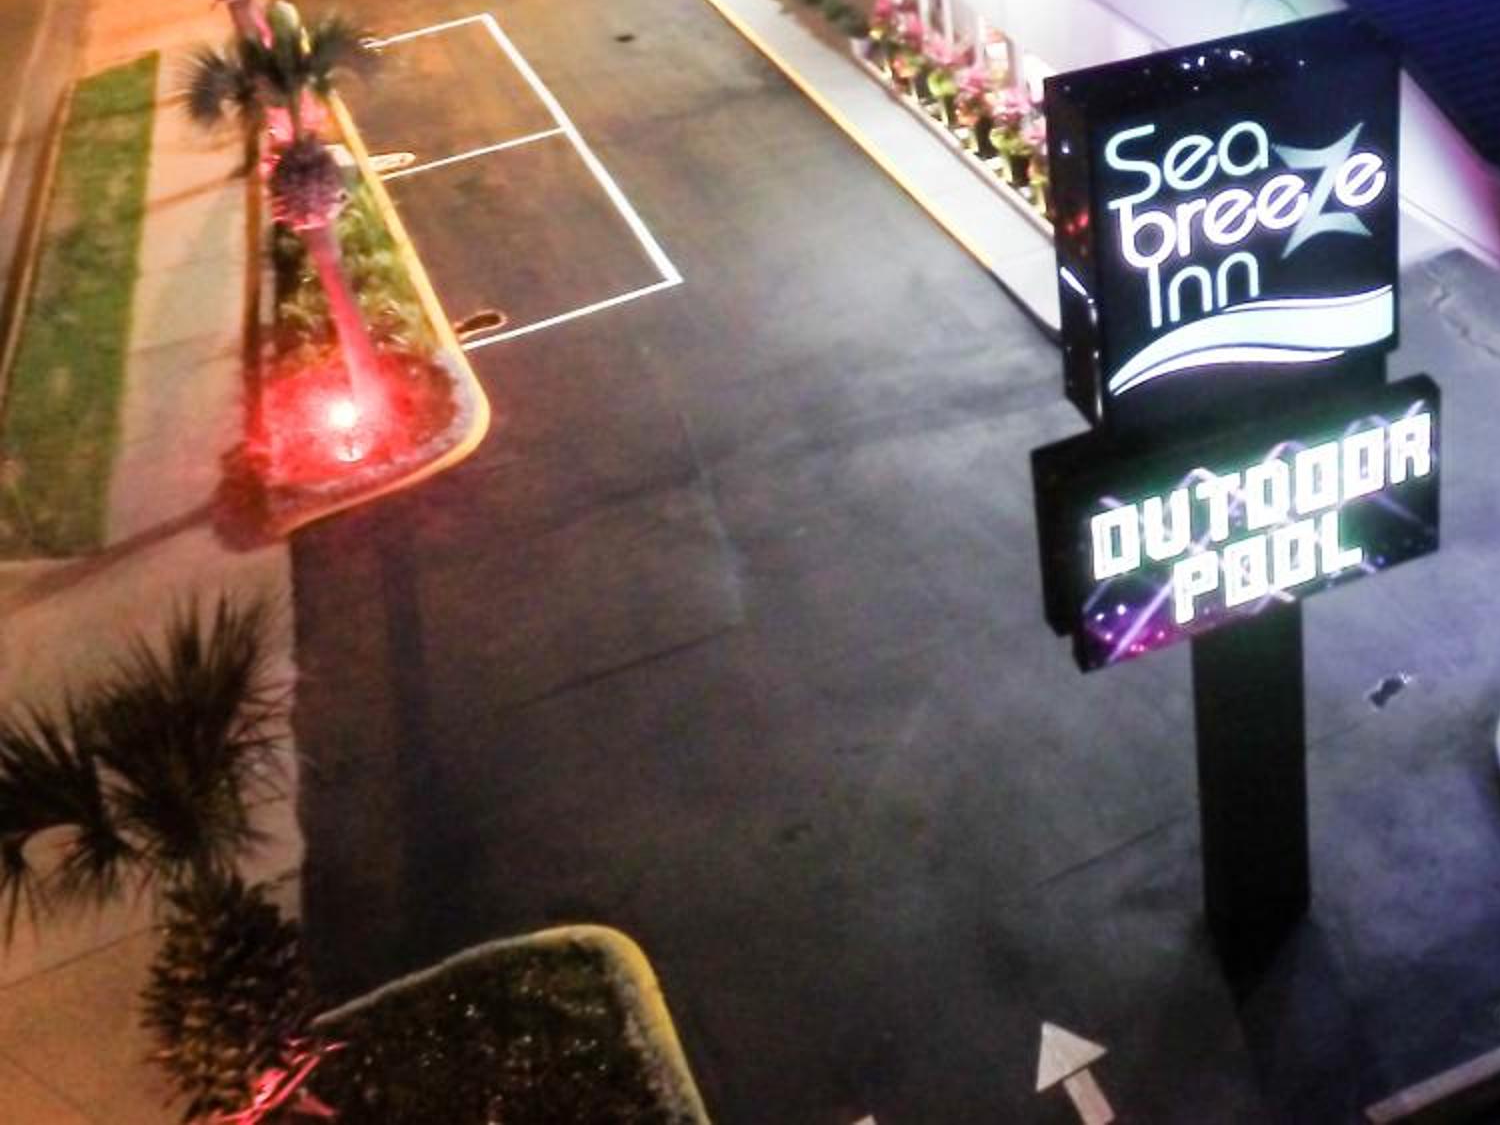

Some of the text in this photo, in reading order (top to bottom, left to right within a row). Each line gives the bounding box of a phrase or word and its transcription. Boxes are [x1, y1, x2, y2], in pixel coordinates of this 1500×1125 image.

[1107, 120, 1268, 209] Sea
[1146, 251, 1258, 328] Inn
[1091, 413, 1431, 580] OUTDOOR
[1171, 511, 1363, 624] POOL
